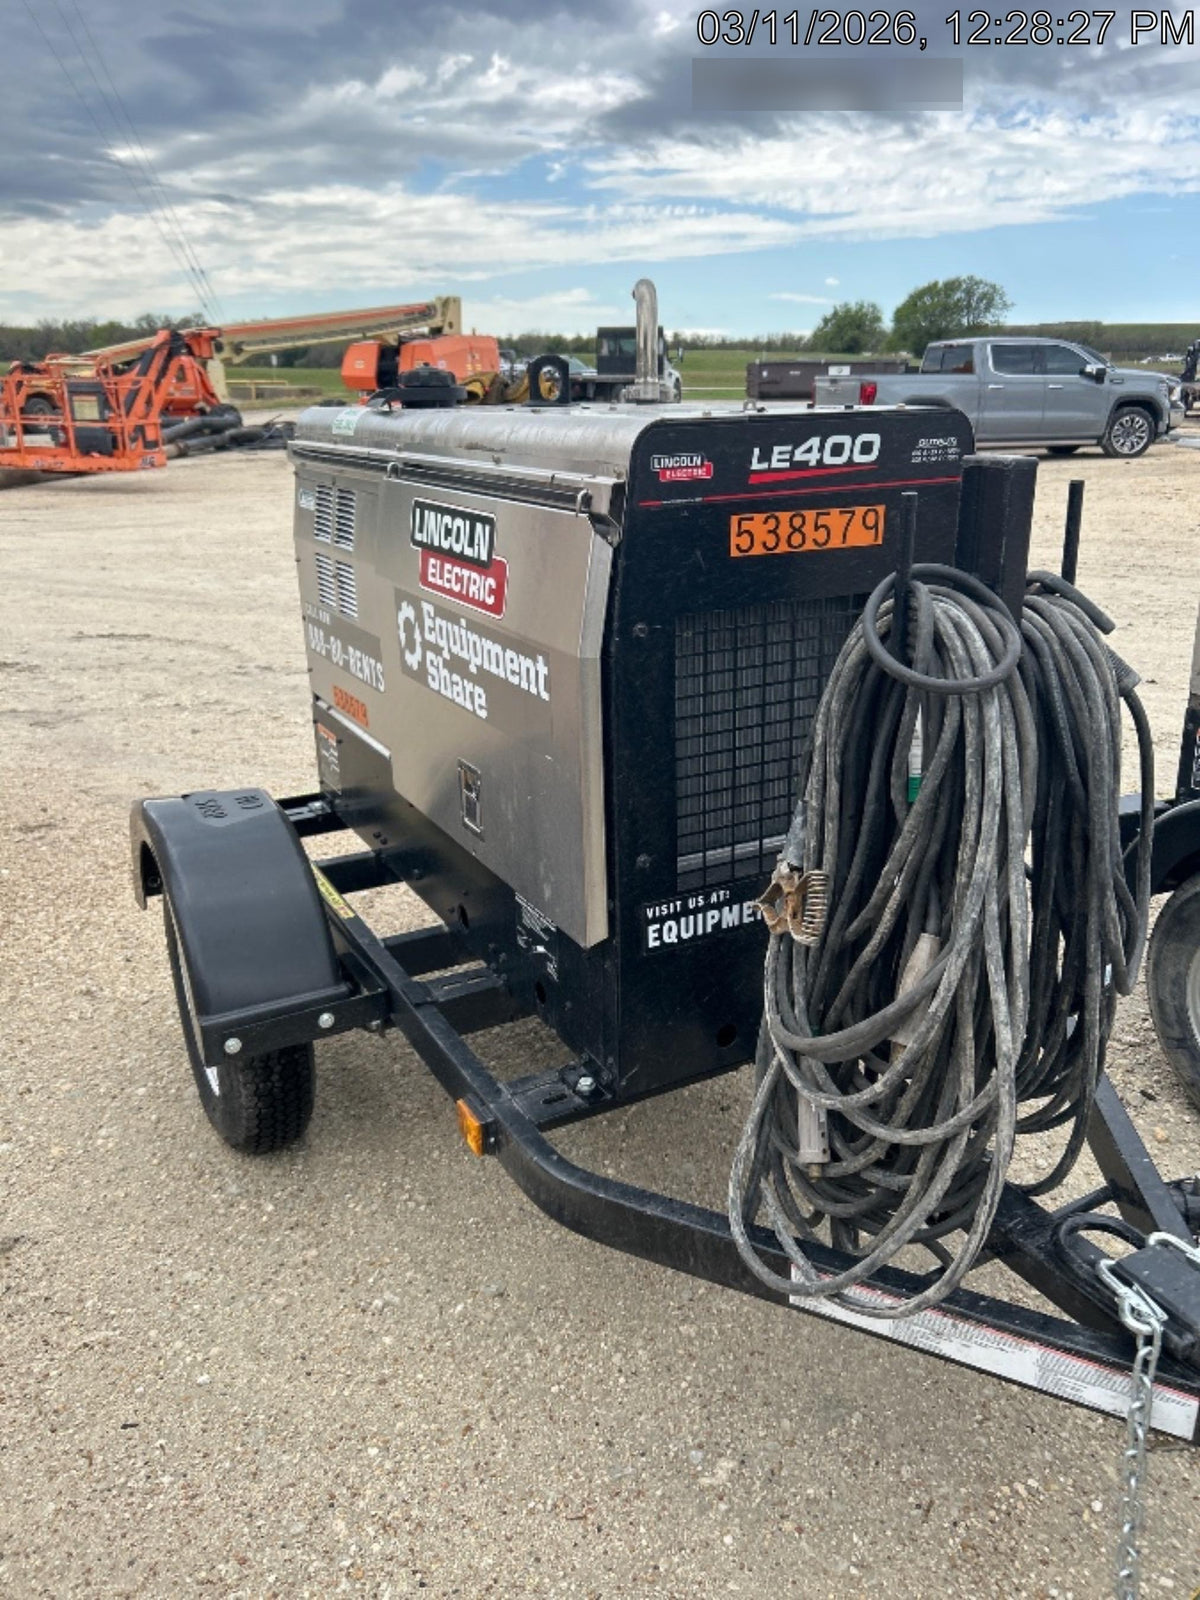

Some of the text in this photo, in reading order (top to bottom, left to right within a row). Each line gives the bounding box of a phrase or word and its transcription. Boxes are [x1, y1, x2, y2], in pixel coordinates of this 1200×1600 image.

[653, 455, 702, 468] LINCOLN
[751, 433, 881, 471] LE400
[414, 507, 491, 562] LINCOLN
[735, 508, 880, 554] 538579
[427, 557, 497, 606] ELECTRIC
[421, 600, 550, 701] Equipment
[425, 650, 488, 719] Share
[646, 890, 730, 919] VISIT US AT:
